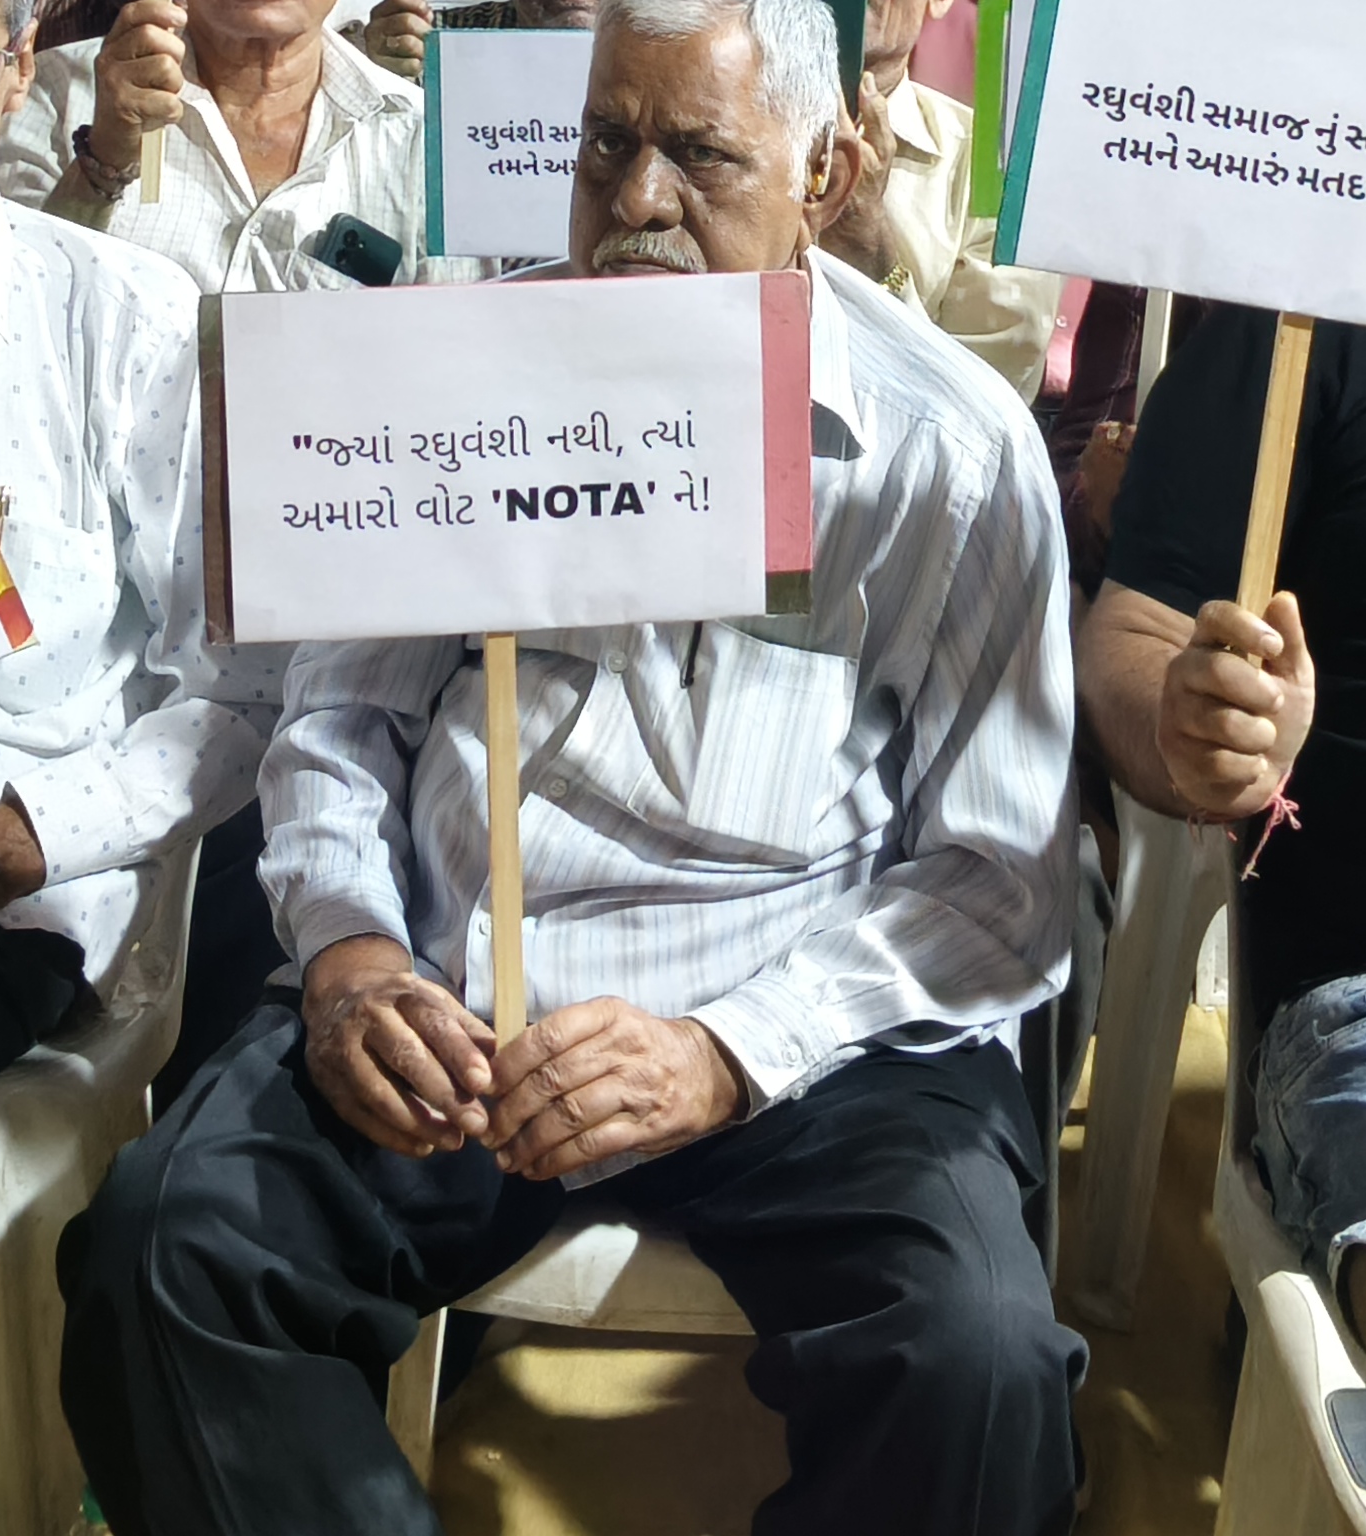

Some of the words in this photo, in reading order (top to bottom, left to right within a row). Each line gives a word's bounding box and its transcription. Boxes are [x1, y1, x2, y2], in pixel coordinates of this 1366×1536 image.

[467, 119, 544, 150] રઘુવંશી
[1082, 83, 1195, 123] રઘુવંશી
[1202, 102, 1310, 140] સમાજ
[1315, 113, 1339, 156] નું
[488, 151, 539, 175] તમને
[1104, 132, 1178, 170] તમને
[1186, 148, 1289, 186] અમારું
[293, 425, 394, 466] "જ્યાં
[410, 415, 531, 472] રઘુવંશી
[547, 411, 623, 457] નથી,
[642, 410, 695, 449] ત્યાં
[283, 486, 399, 532] અમારો
[416, 483, 475, 525] વોટ
[492, 481, 655, 522] 'NOTA'
[674, 470, 709, 511] ને!
